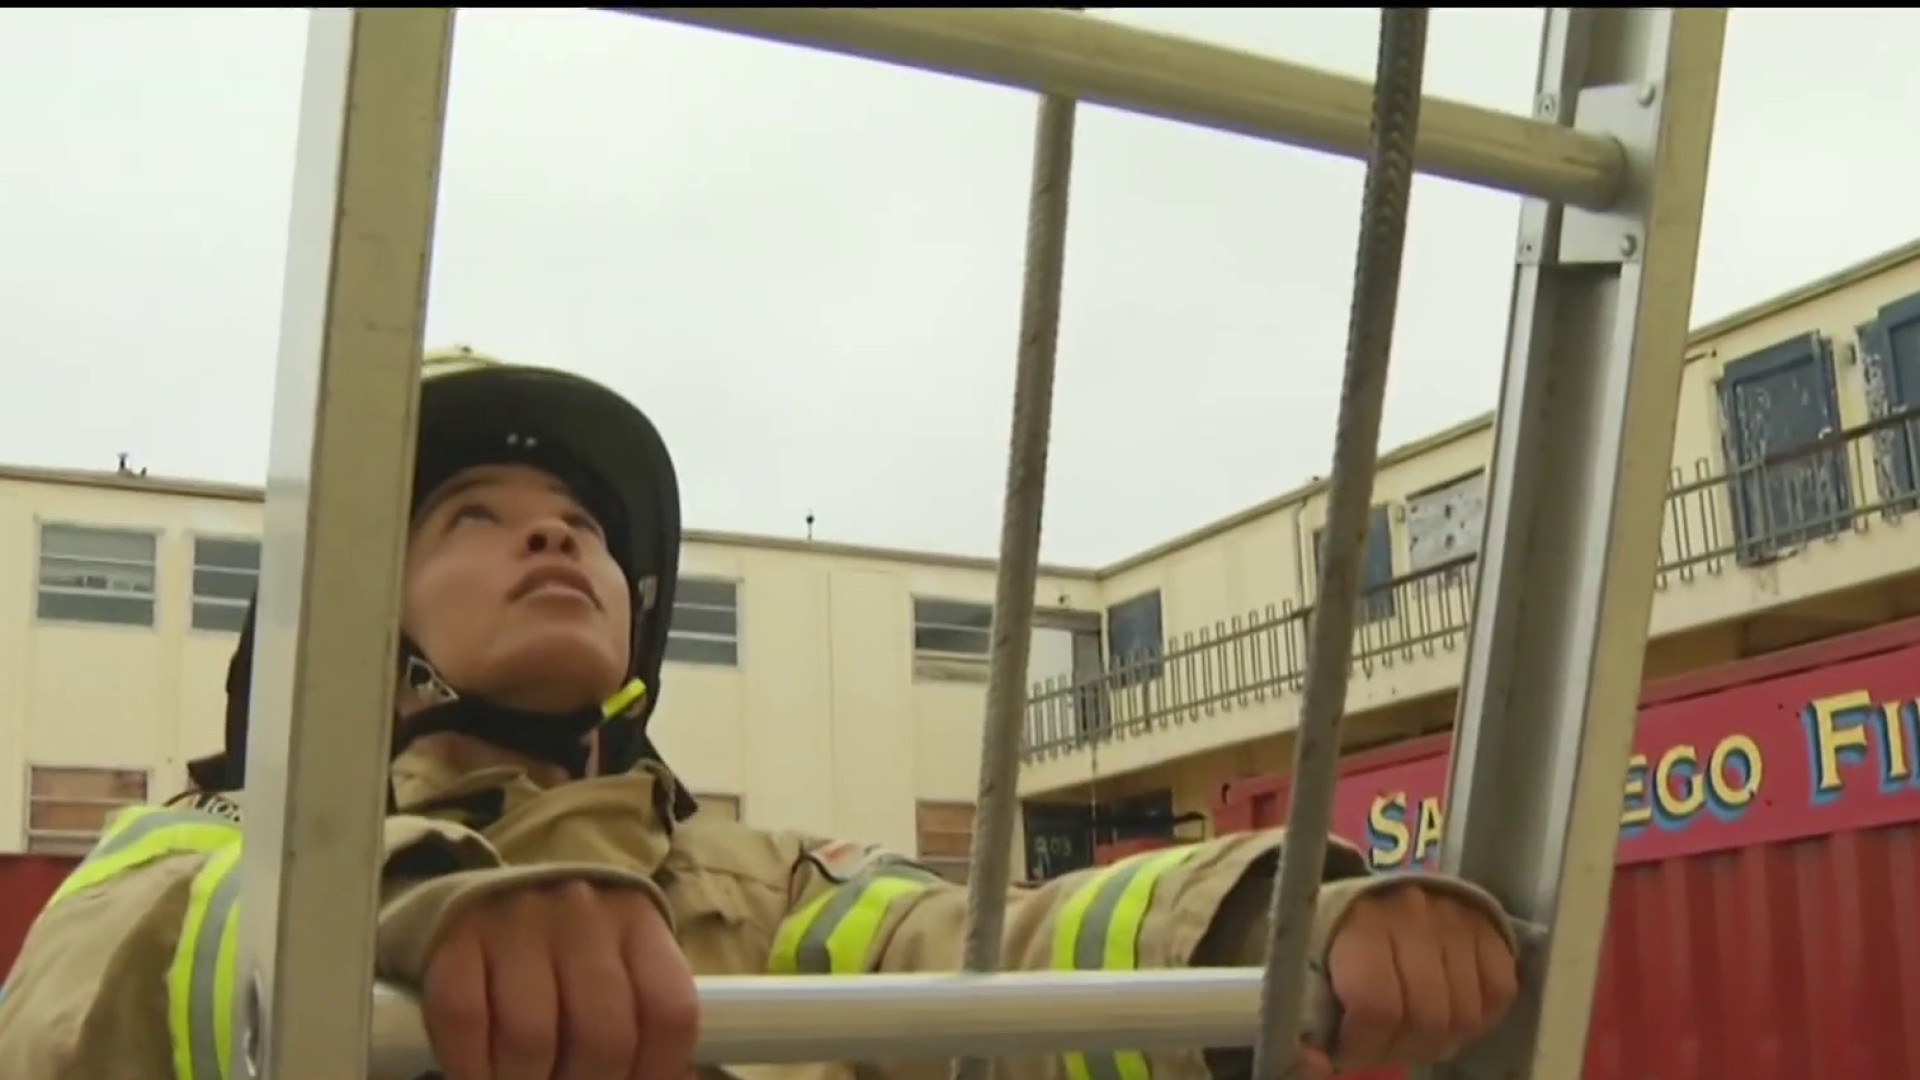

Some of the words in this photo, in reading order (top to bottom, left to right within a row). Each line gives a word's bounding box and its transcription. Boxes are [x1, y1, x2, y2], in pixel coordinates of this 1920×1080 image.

[1367, 790, 1442, 870] SA
[1618, 734, 1763, 831] EGO
[1806, 689, 1920, 797] FI
